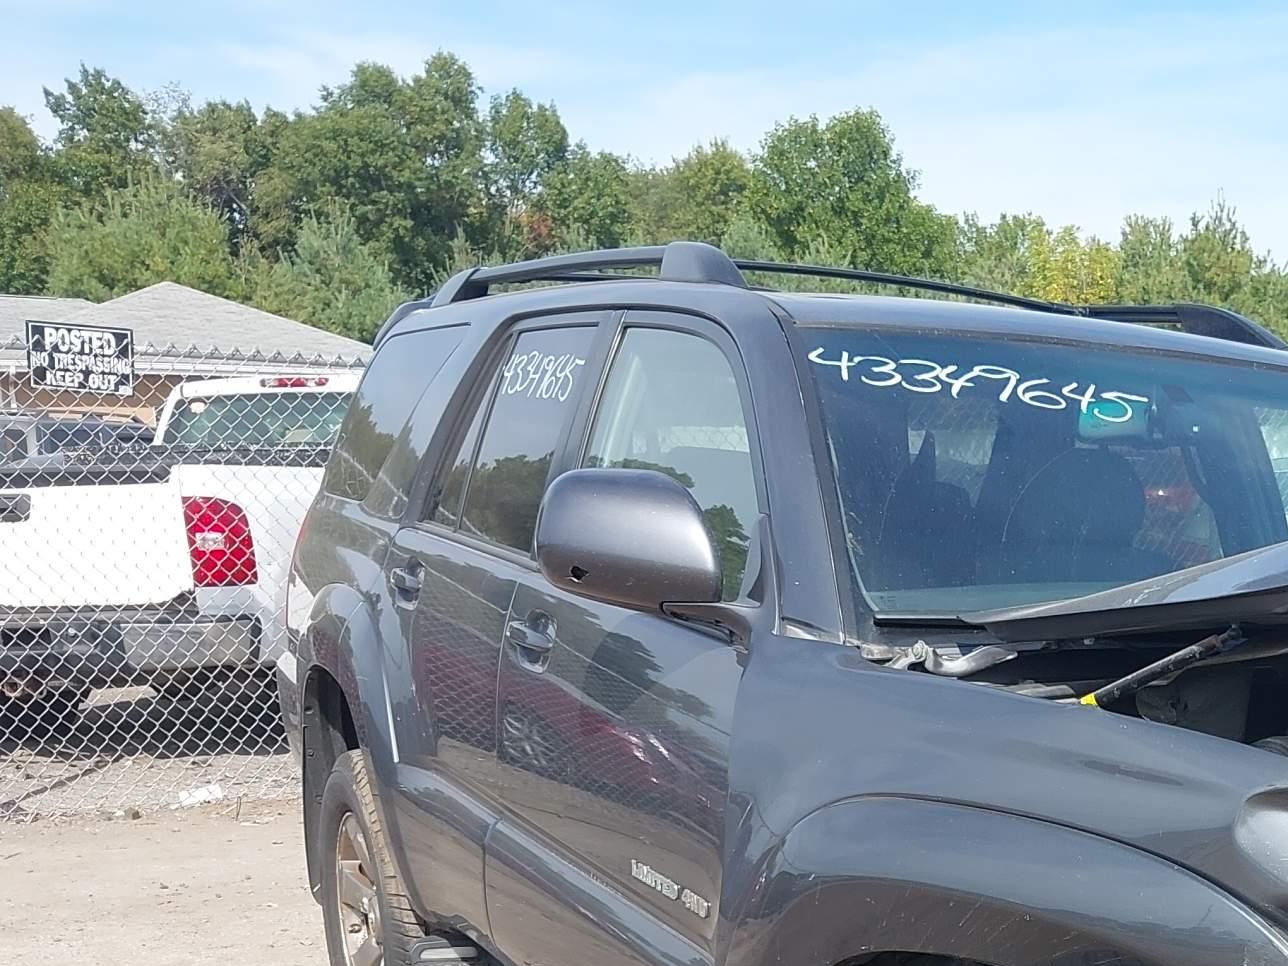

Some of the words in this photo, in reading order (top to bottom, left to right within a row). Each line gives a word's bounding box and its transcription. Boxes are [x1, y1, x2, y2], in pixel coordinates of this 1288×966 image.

[43, 326, 117, 356] POSTED
[31, 350, 49, 368] NO
[52, 351, 132, 376] TRESPASSING
[501, 350, 586, 402] 43349645
[45, 369, 85, 388] KEEP
[88, 373, 118, 391] OUT
[807, 346, 1150, 424] 43349645
